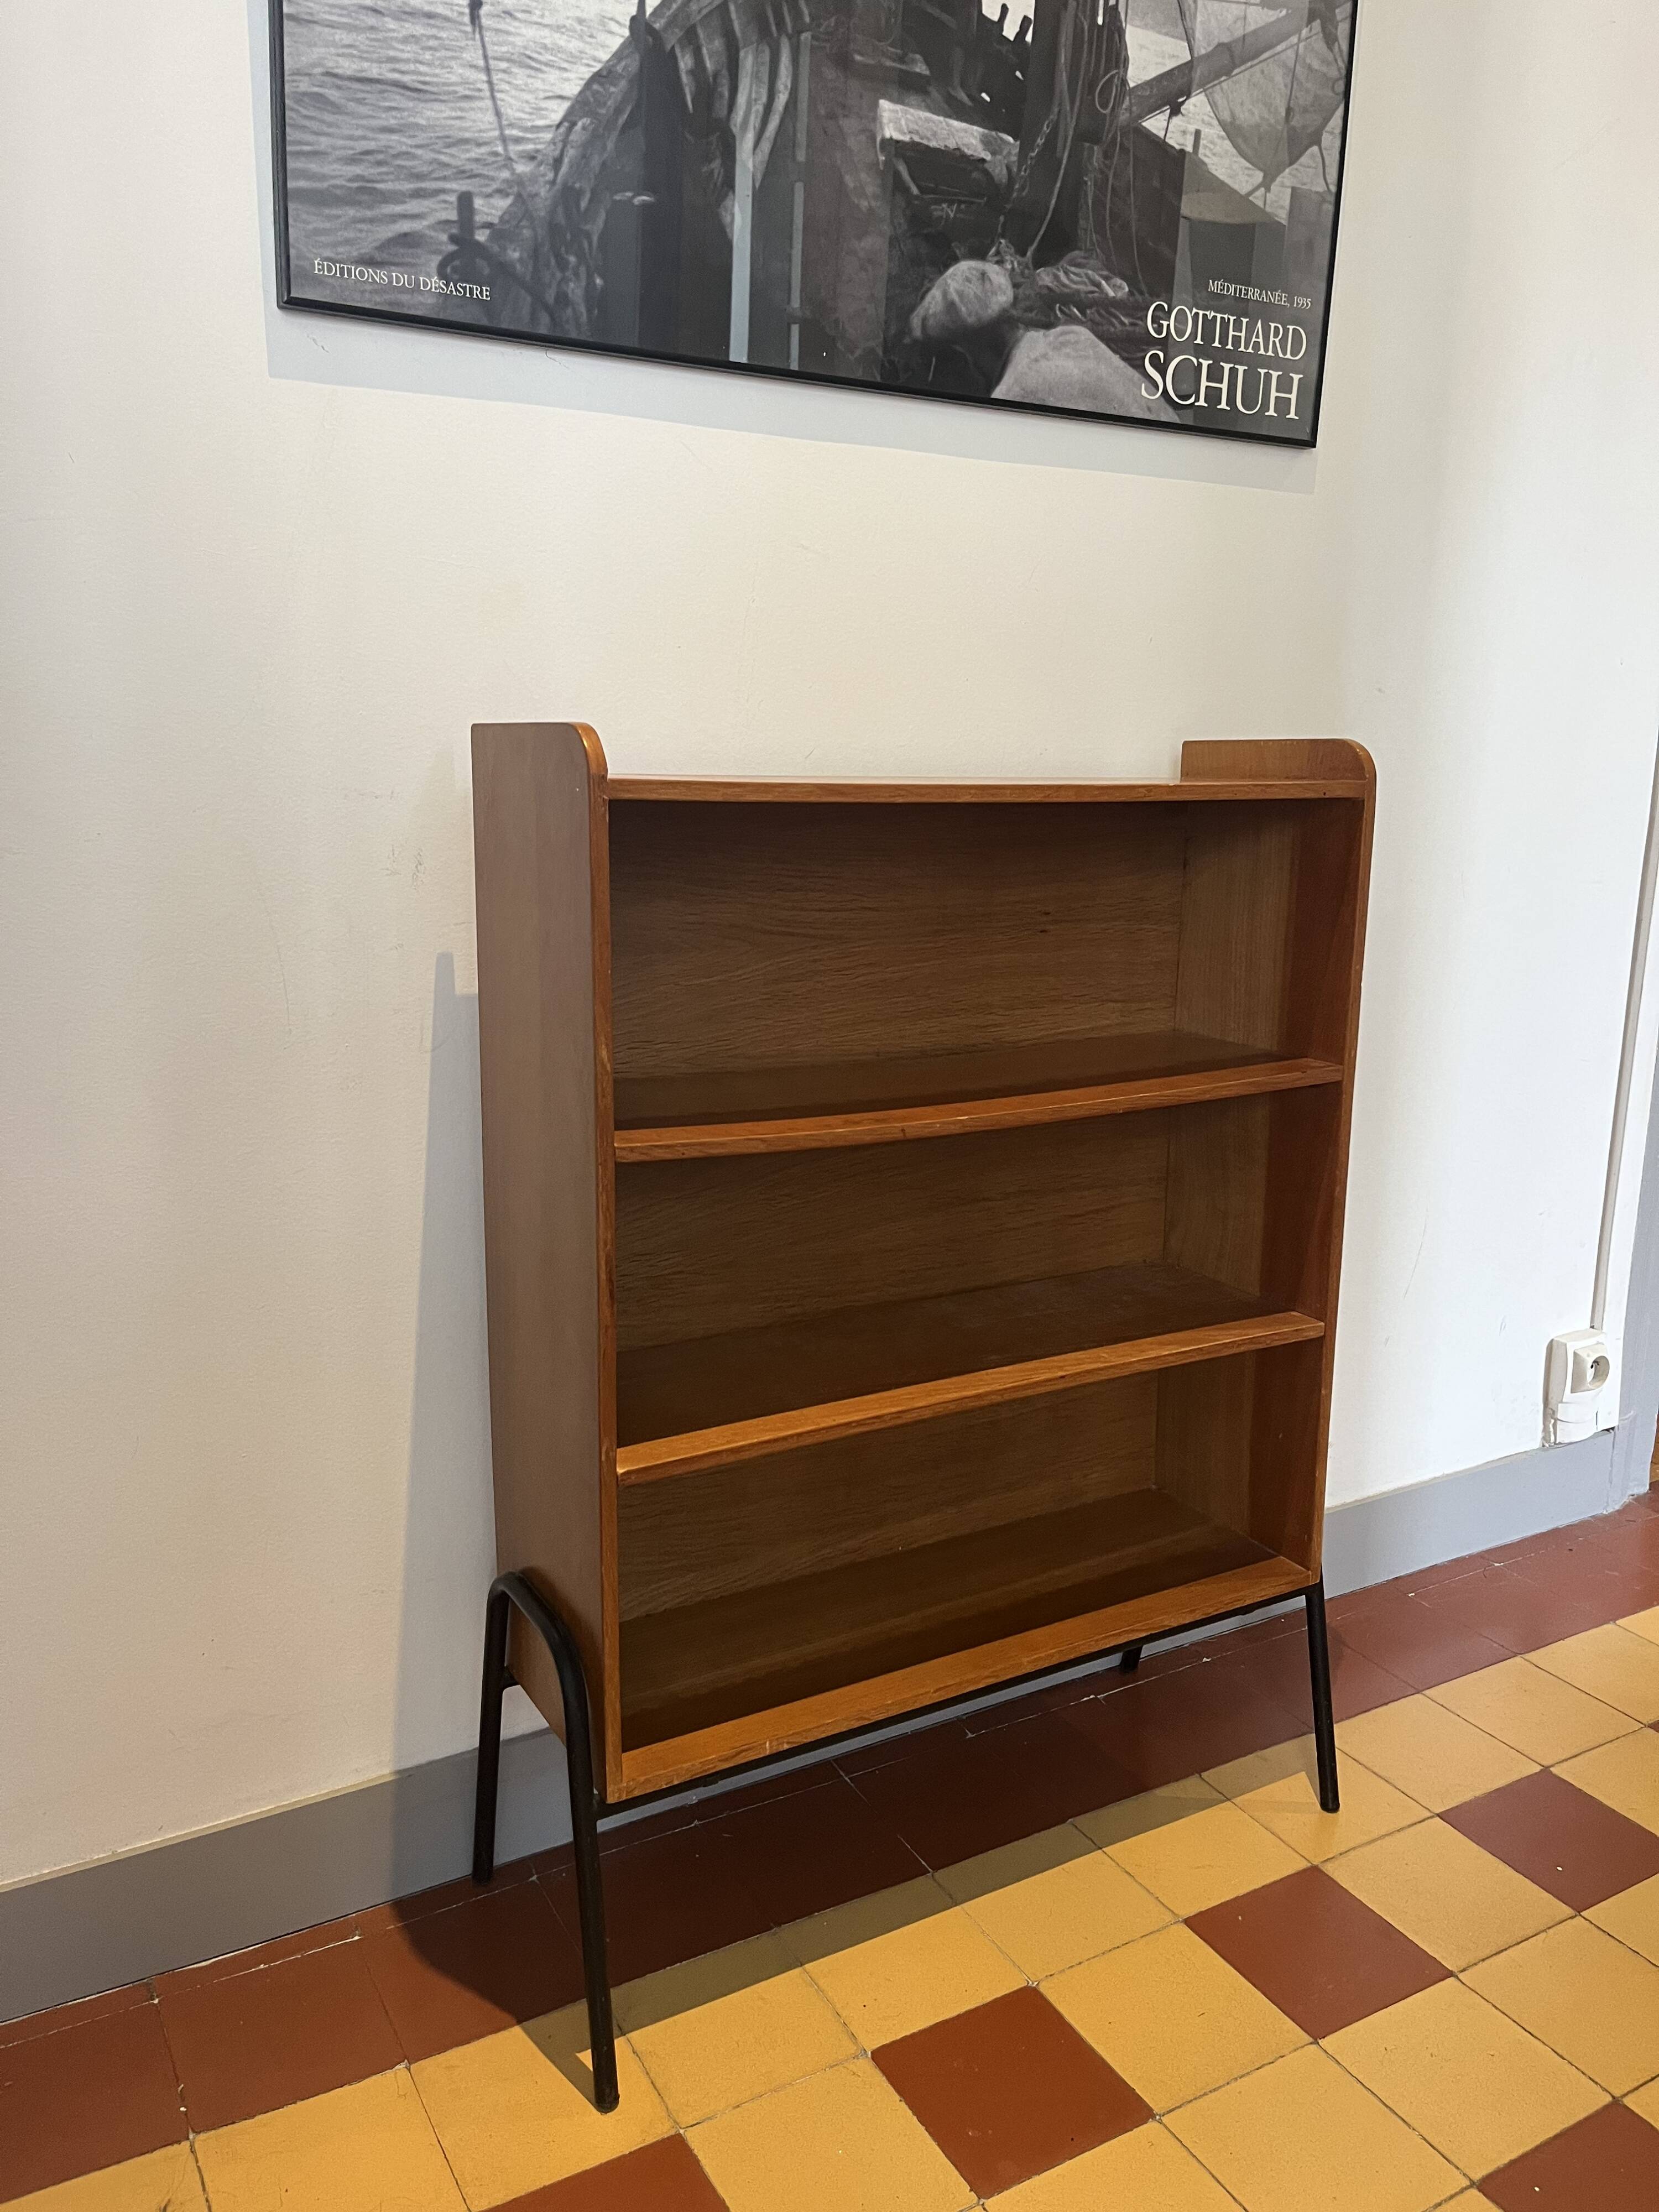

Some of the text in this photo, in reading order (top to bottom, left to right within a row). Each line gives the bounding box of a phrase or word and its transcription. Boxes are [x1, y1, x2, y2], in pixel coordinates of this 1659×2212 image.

[314, 258, 491, 300] ÉDITIONS DU DÉSASTRE
[1208, 279, 1312, 310] MÉDITERRANÉE, 1935
[1147, 301, 1307, 360] GOTTHARD
[1141, 350, 1303, 419] SCHUH
